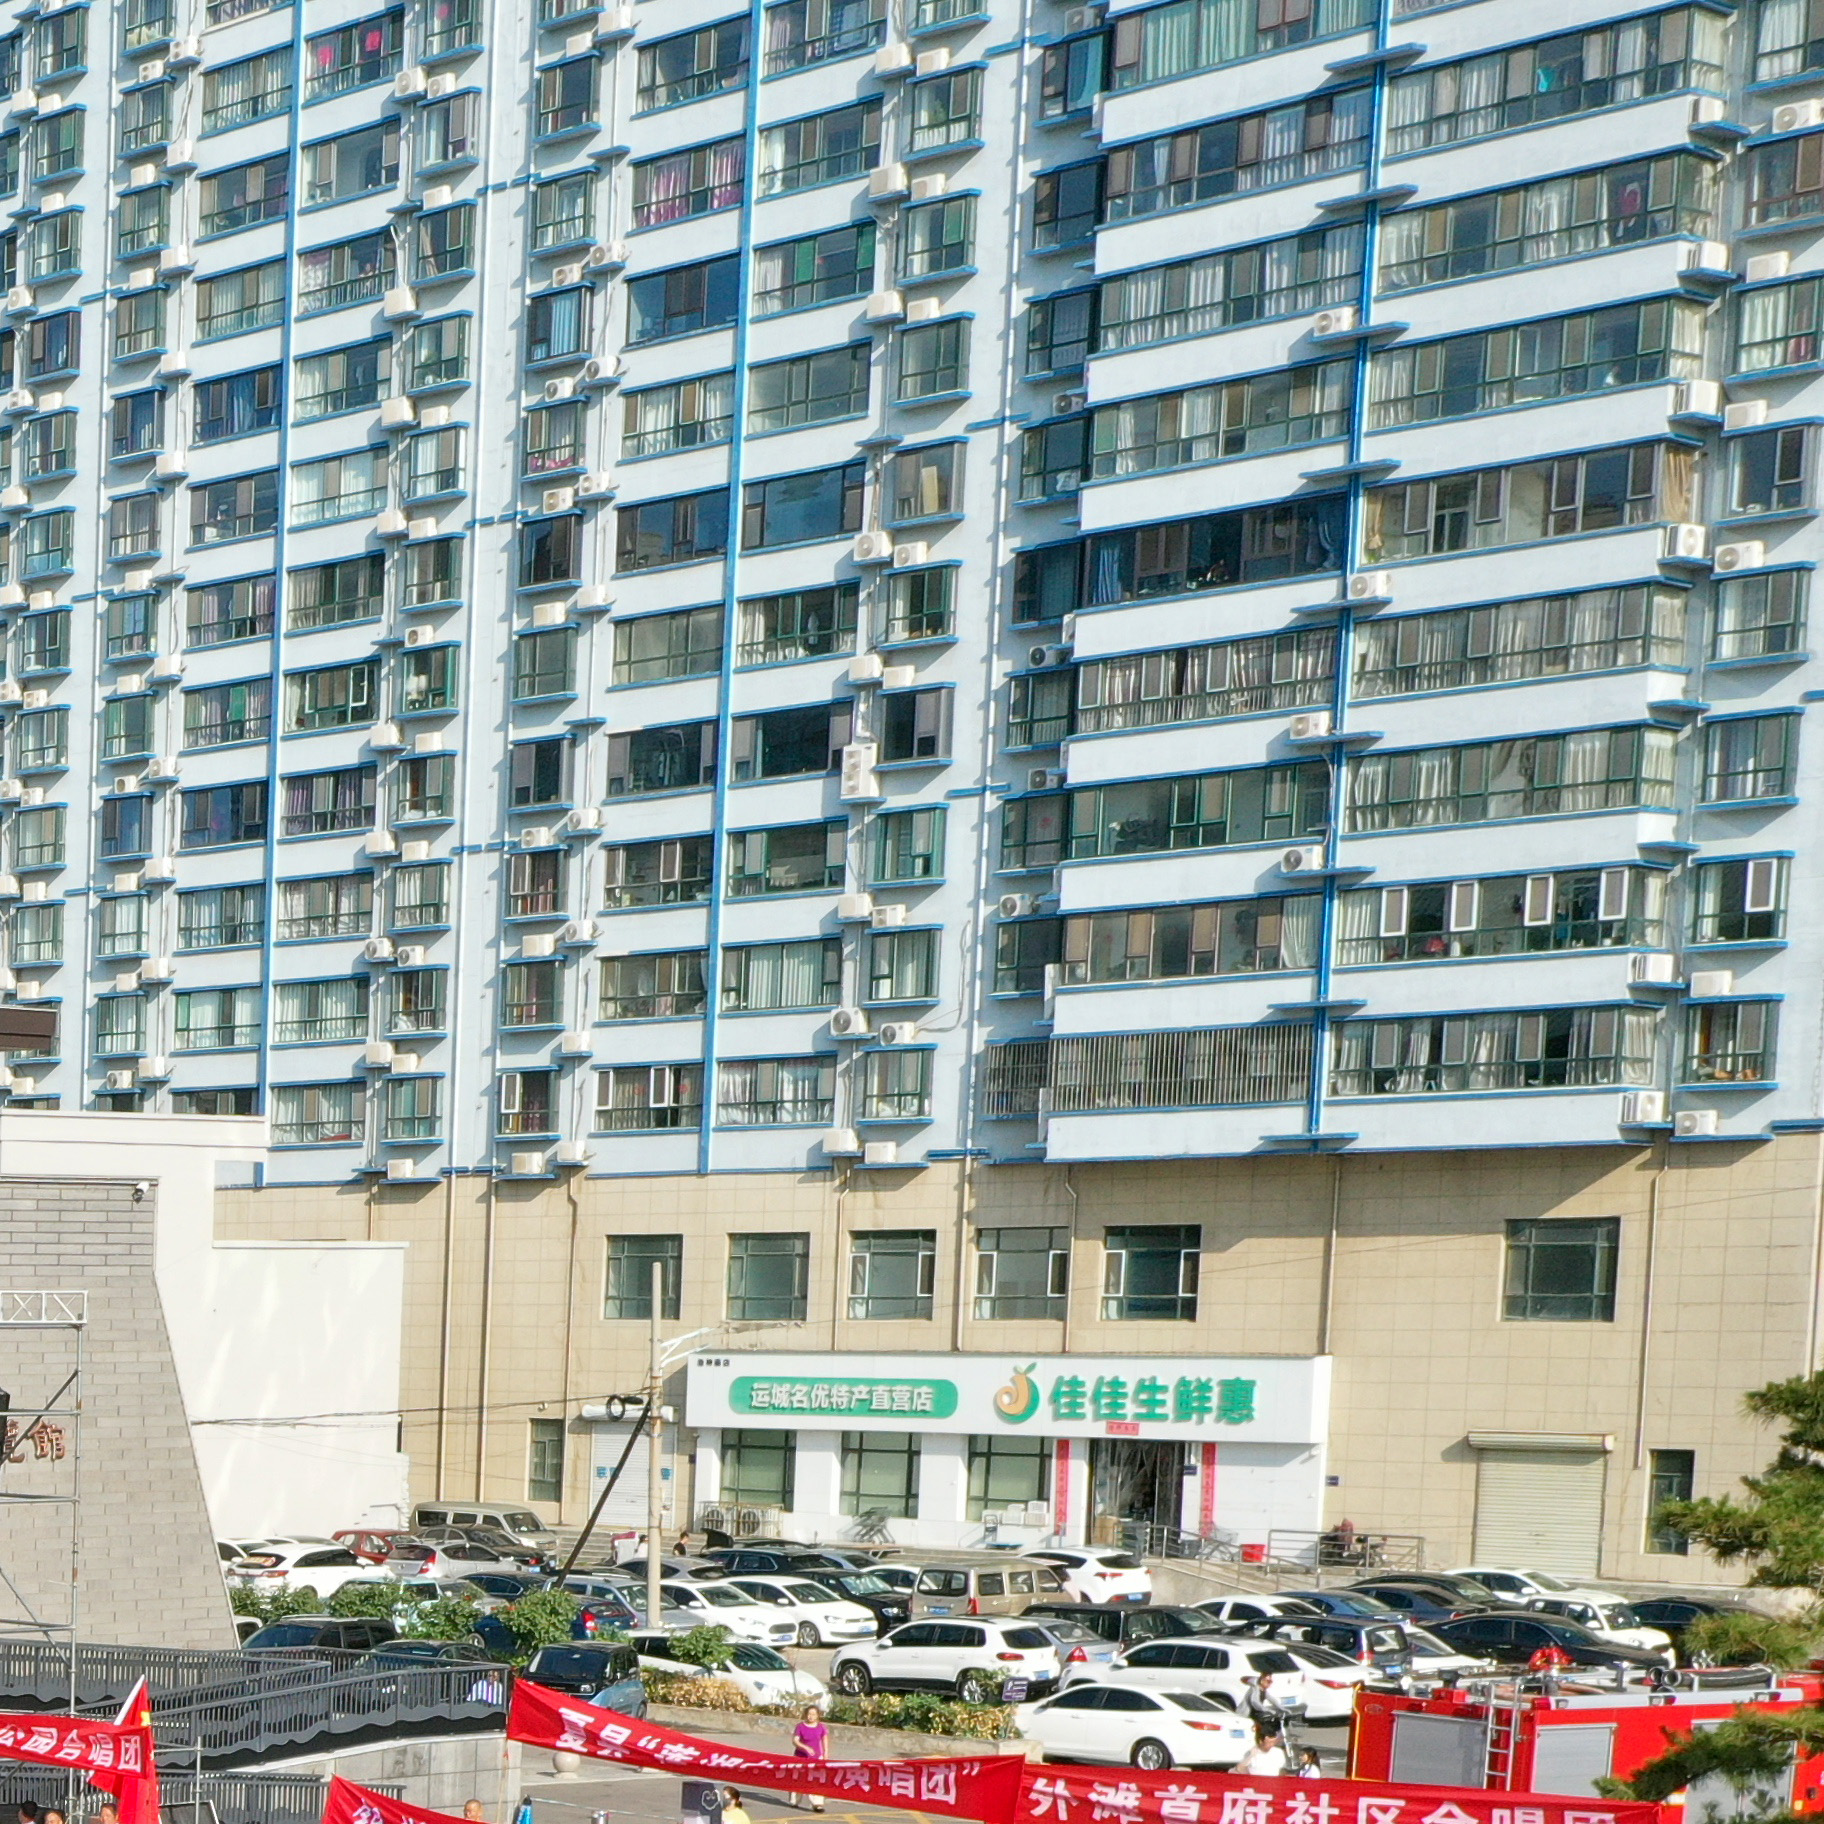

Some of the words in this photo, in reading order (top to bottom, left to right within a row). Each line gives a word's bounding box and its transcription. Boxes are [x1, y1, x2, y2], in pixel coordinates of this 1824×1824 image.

[750, 1381, 934, 1413] 运城名优特产直营店
[1049, 1374, 1258, 1425] 佳佳生鲜惠
